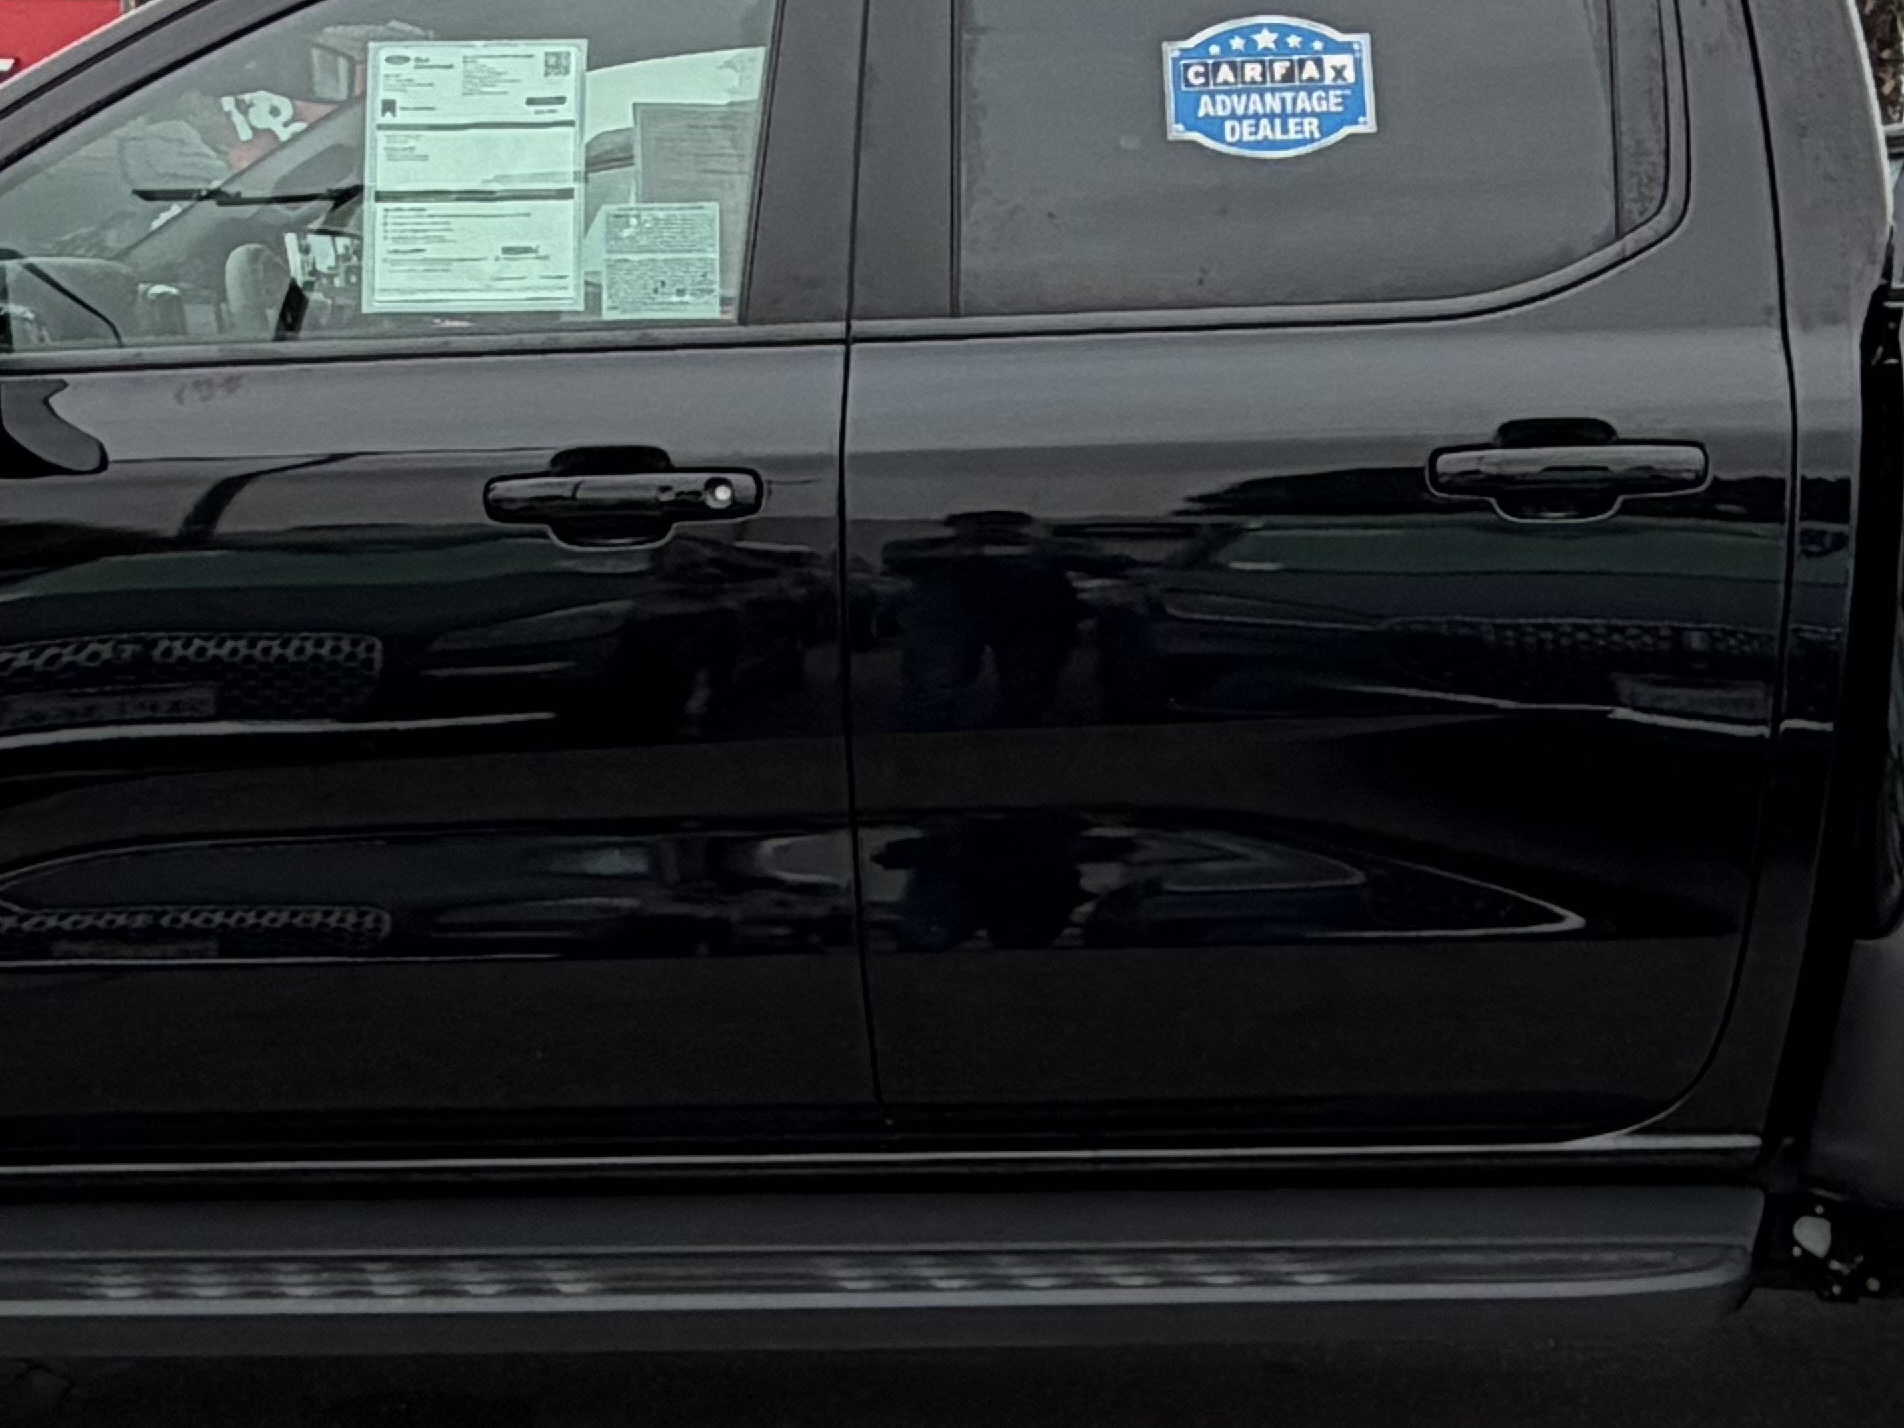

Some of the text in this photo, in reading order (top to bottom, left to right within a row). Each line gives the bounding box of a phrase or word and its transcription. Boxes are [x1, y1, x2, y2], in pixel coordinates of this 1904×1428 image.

[1184, 58, 1352, 87] CARFAX
[1198, 89, 1345, 118] ADVANTAGE
[1224, 117, 1321, 143] DEALER
